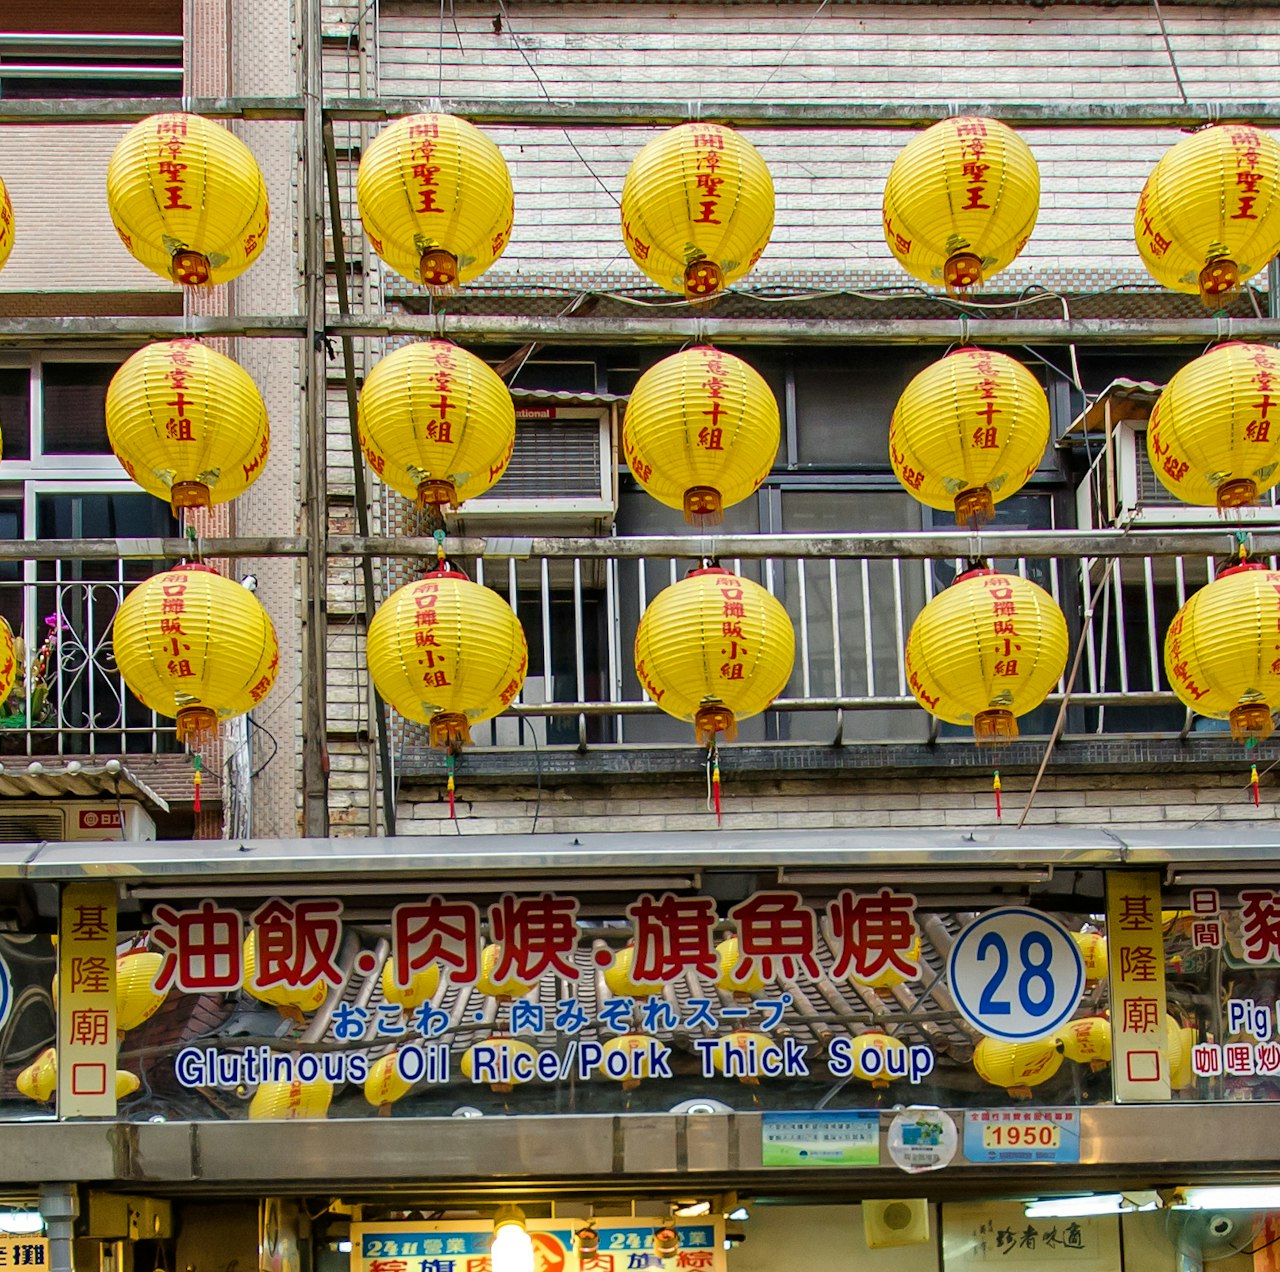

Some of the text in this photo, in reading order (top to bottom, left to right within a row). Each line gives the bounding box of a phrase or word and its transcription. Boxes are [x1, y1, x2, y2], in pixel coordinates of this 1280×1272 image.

[158, 123, 193, 211] 開漳聖王
[411, 126, 446, 214] 開漳聖王
[694, 136, 725, 226] 開漳聖王
[959, 125, 991, 212] 開漳聖王
[1232, 135, 1265, 221] 開漳聖王
[1192, 890, 1219, 947] 日間
[69, 904, 111, 1097] 基隆廟口
[976, 931, 1055, 1016] 28
[1119, 895, 1160, 1082] 基隆廟口
[176, 1038, 934, 1086] Glutinous Oil Rice/Pork Thick Soup
[1230, 1002, 1268, 1036] Pig
[991, 1127, 1052, 1145] 1950
